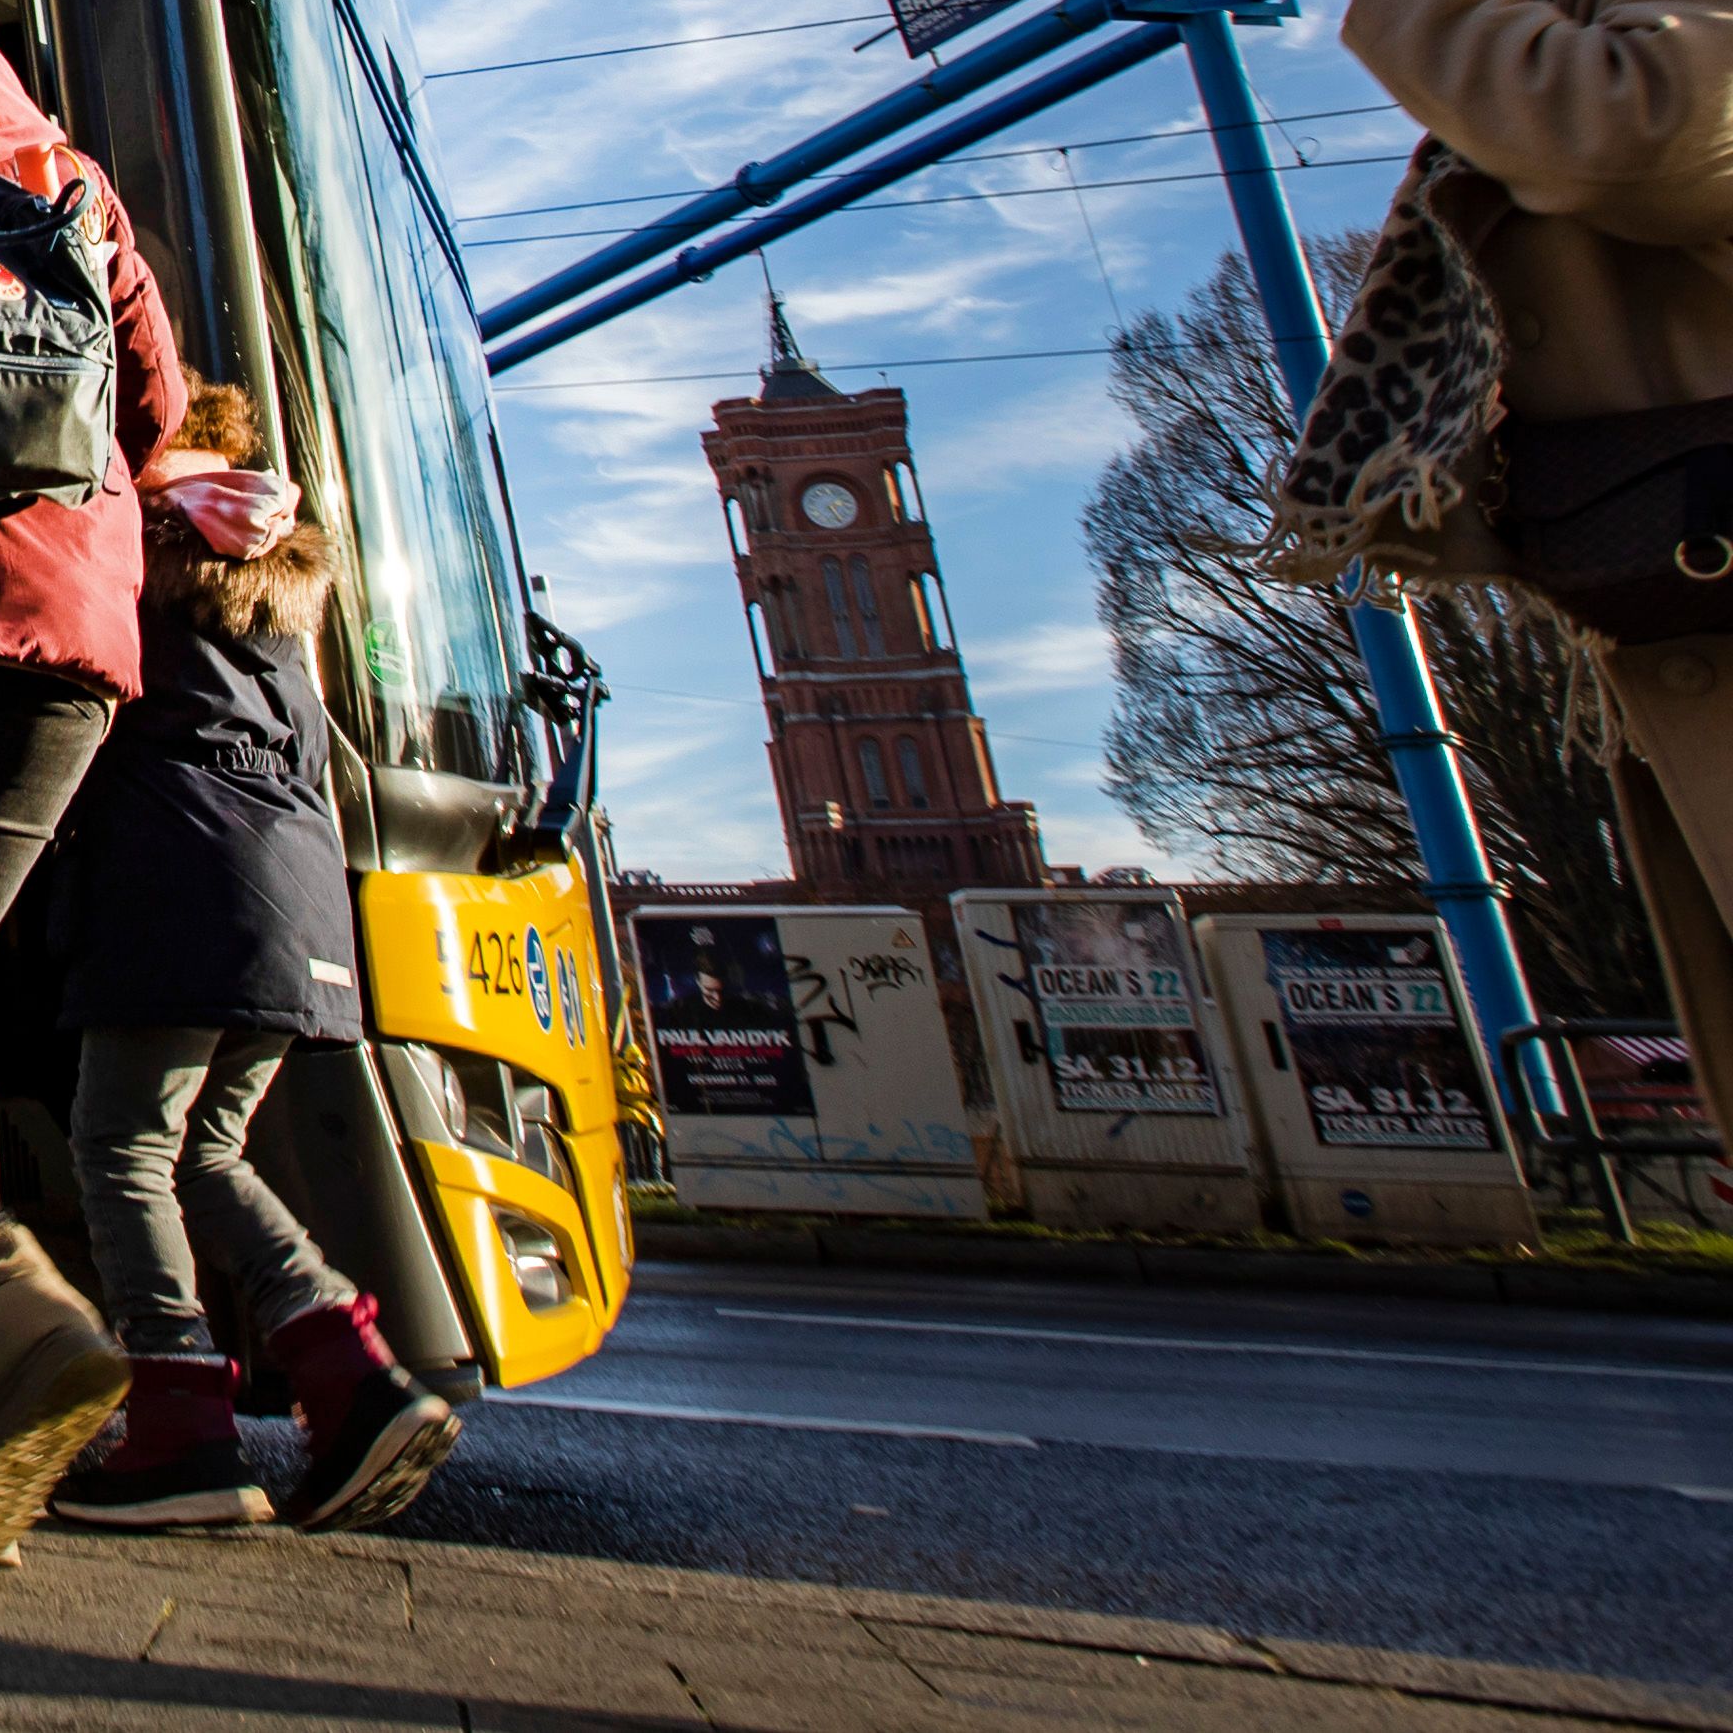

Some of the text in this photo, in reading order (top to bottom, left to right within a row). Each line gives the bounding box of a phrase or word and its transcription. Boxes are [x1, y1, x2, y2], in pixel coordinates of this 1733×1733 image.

[1147, 970, 1182, 996] 22
[1406, 985, 1448, 1012] 22
[656, 1029, 792, 1048] PAUL VAN DYK
